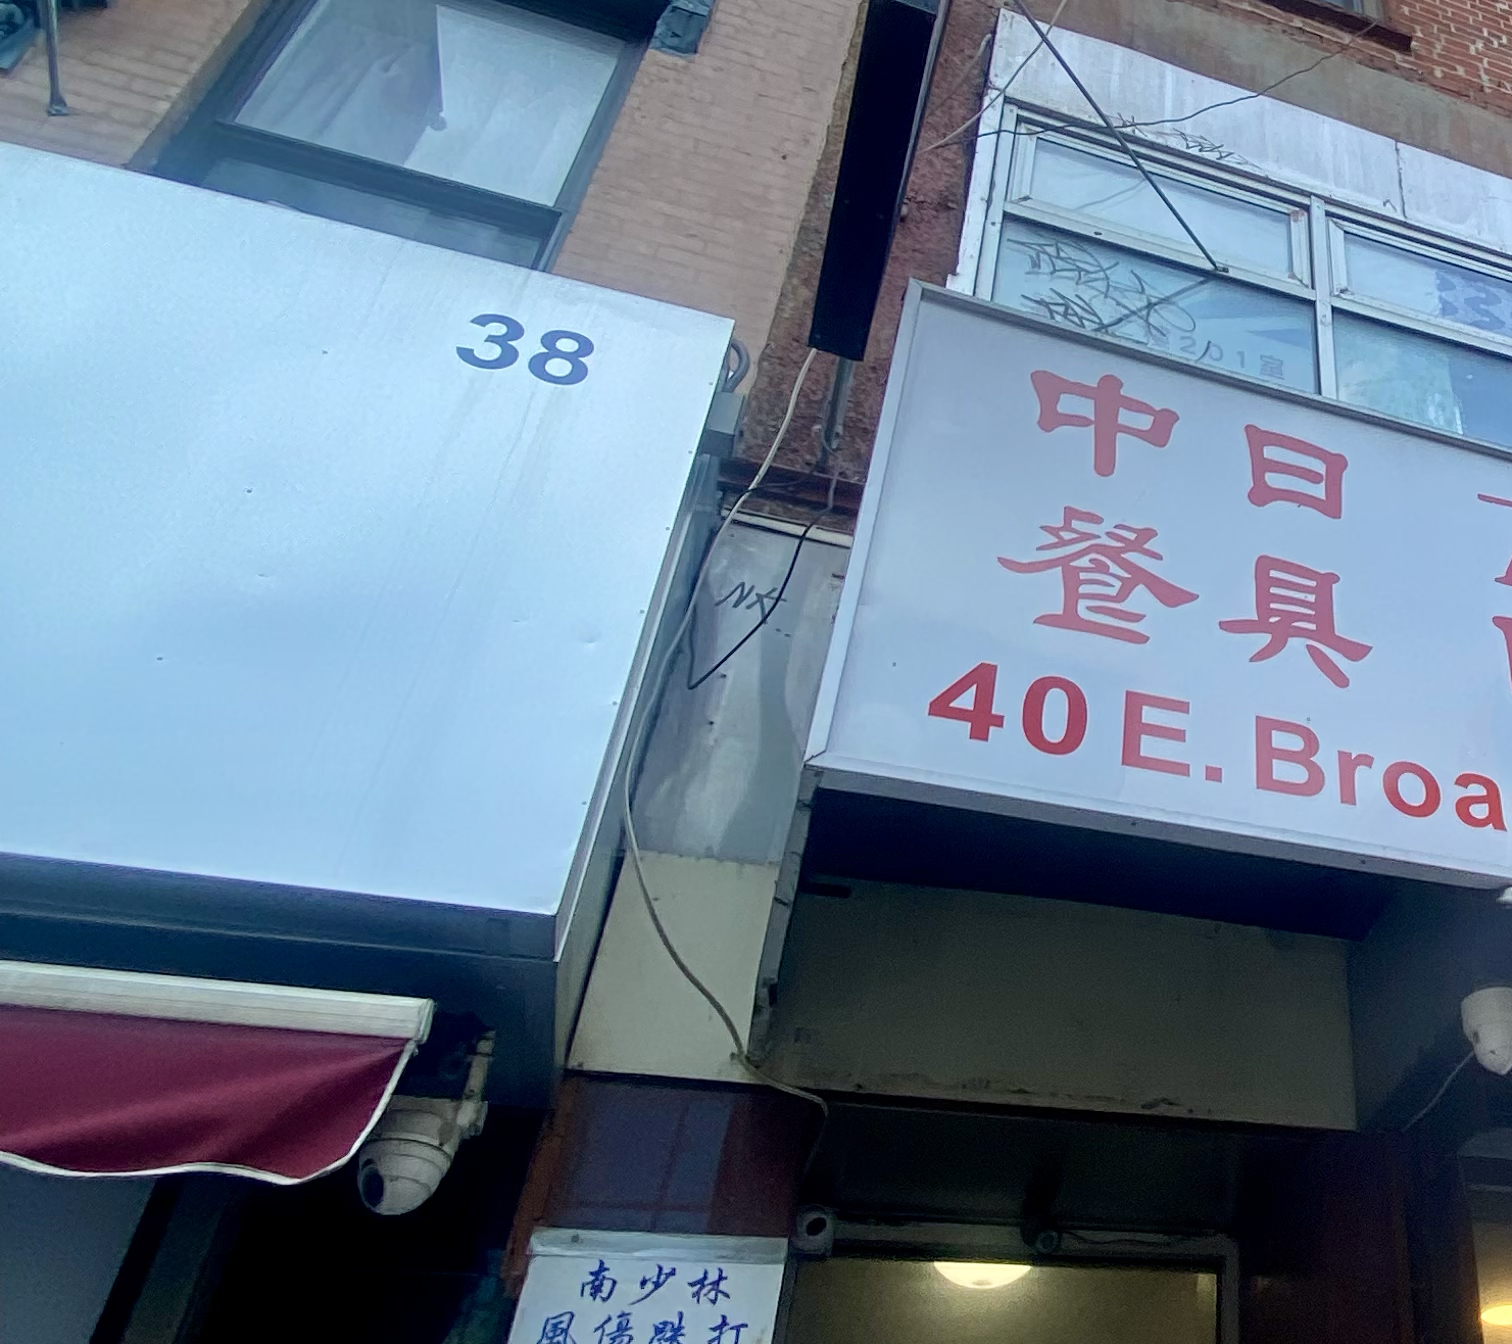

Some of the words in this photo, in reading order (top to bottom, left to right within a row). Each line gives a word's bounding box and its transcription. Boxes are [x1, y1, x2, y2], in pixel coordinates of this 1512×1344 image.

[456, 312, 595, 387] 38
[996, 506, 1374, 688] 餐具
[928, 662, 1088, 757] 40
[1120, 690, 1223, 784] E.
[579, 1259, 732, 1306] 南少林
